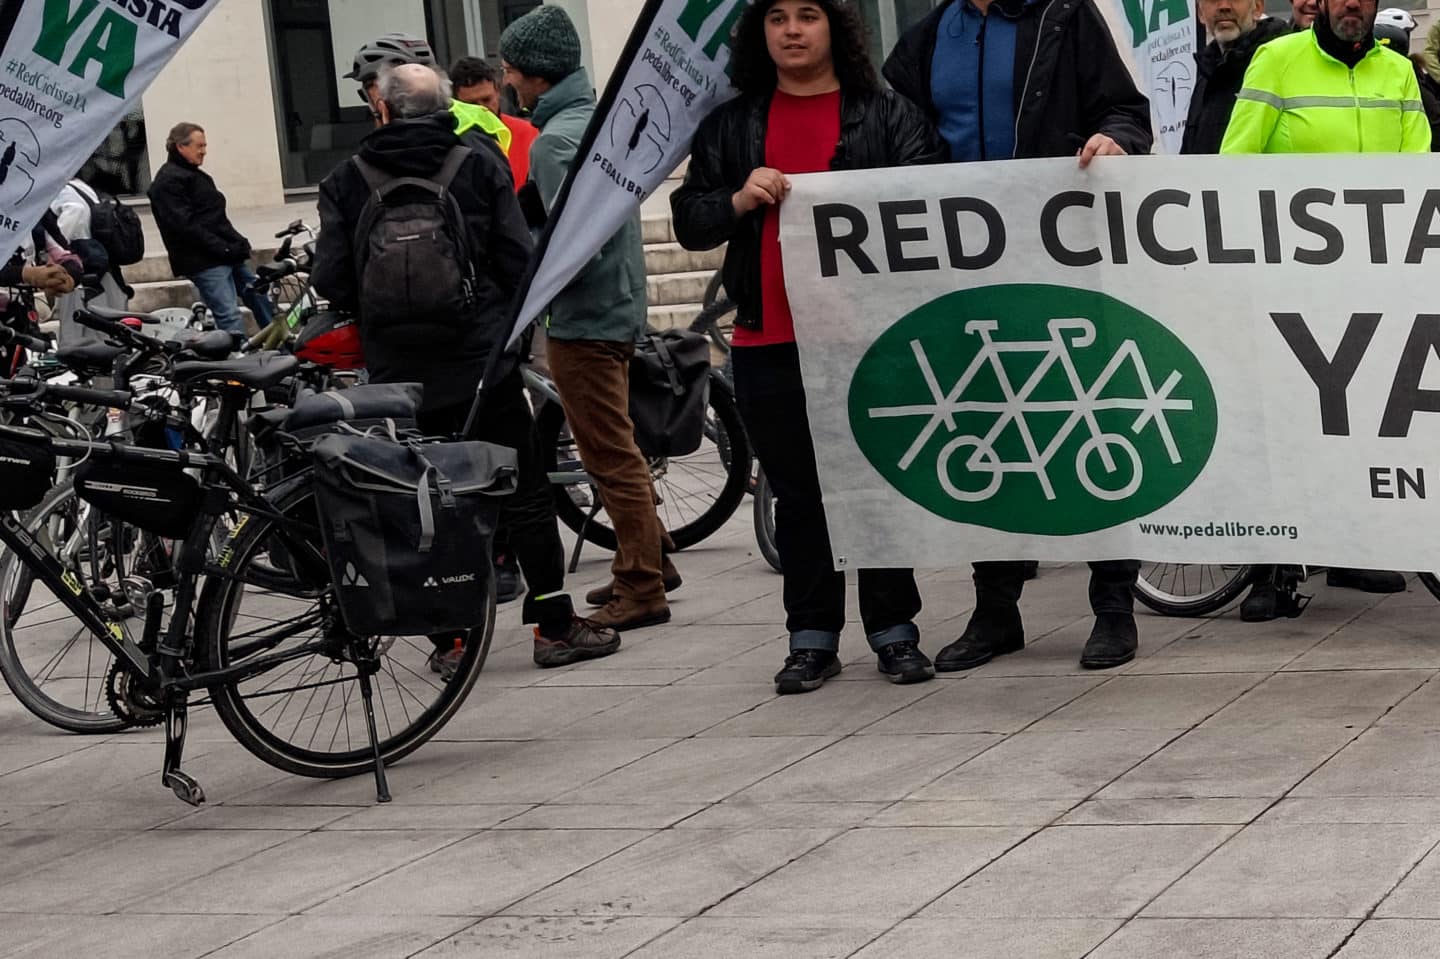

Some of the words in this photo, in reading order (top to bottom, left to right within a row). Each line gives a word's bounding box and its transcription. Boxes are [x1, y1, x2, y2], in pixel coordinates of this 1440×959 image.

[812, 196, 1006, 278] RED
[1369, 467, 1426, 500] EN
[1139, 522, 1299, 540] www.pedalibre.org
